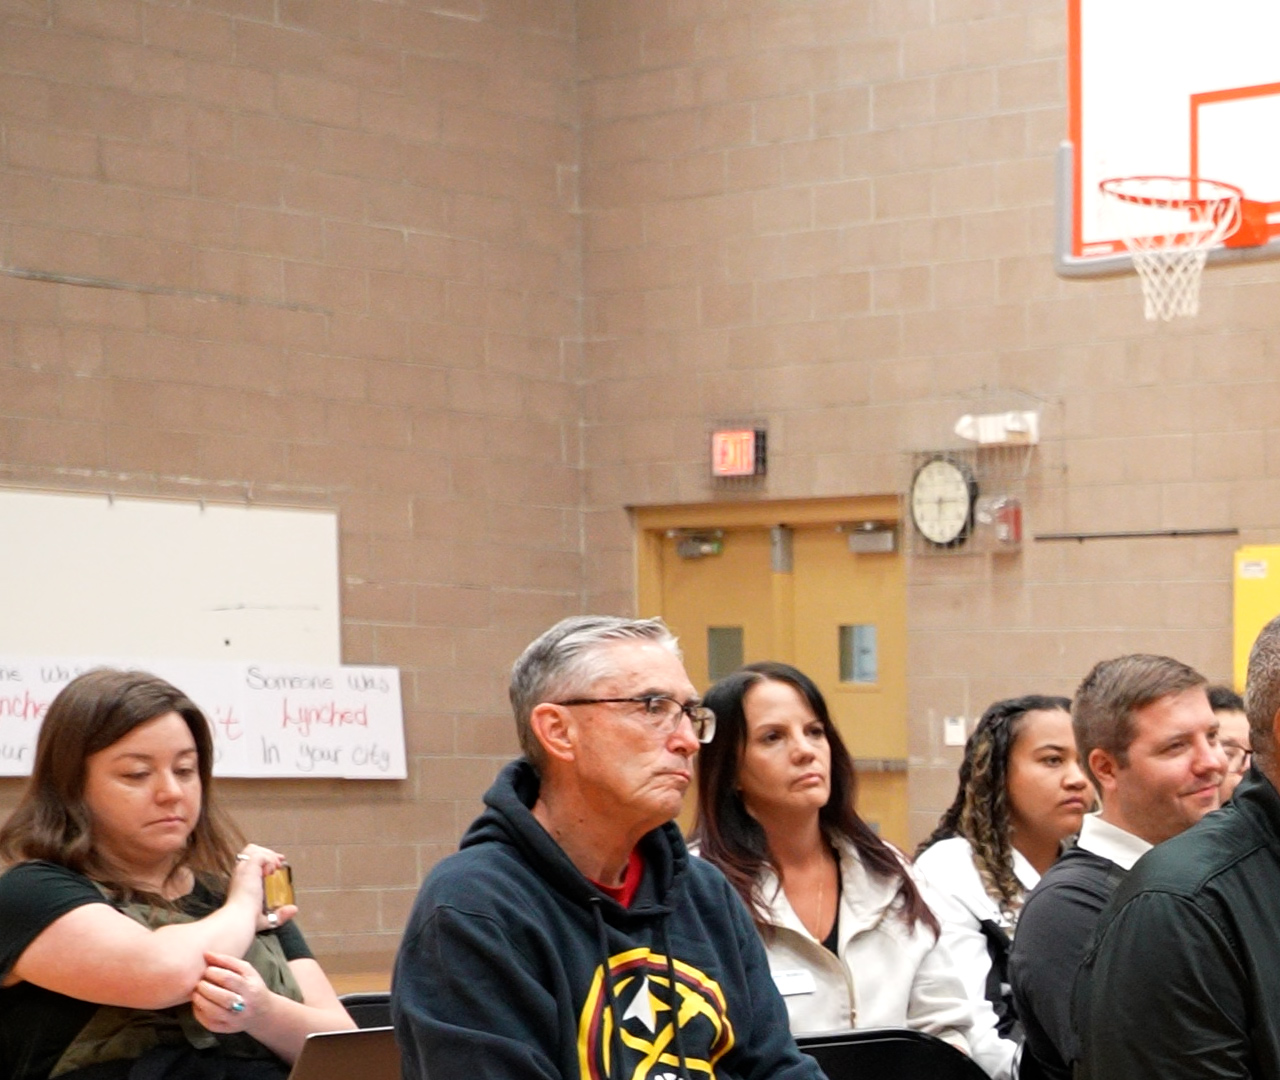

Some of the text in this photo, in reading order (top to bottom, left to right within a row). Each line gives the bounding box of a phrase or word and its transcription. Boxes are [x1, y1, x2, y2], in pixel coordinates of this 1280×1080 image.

[246, 665, 334, 690] Someone
[281, 697, 369, 738] Lynched
[260, 735, 281, 764] In
[295, 743, 342, 772] your
